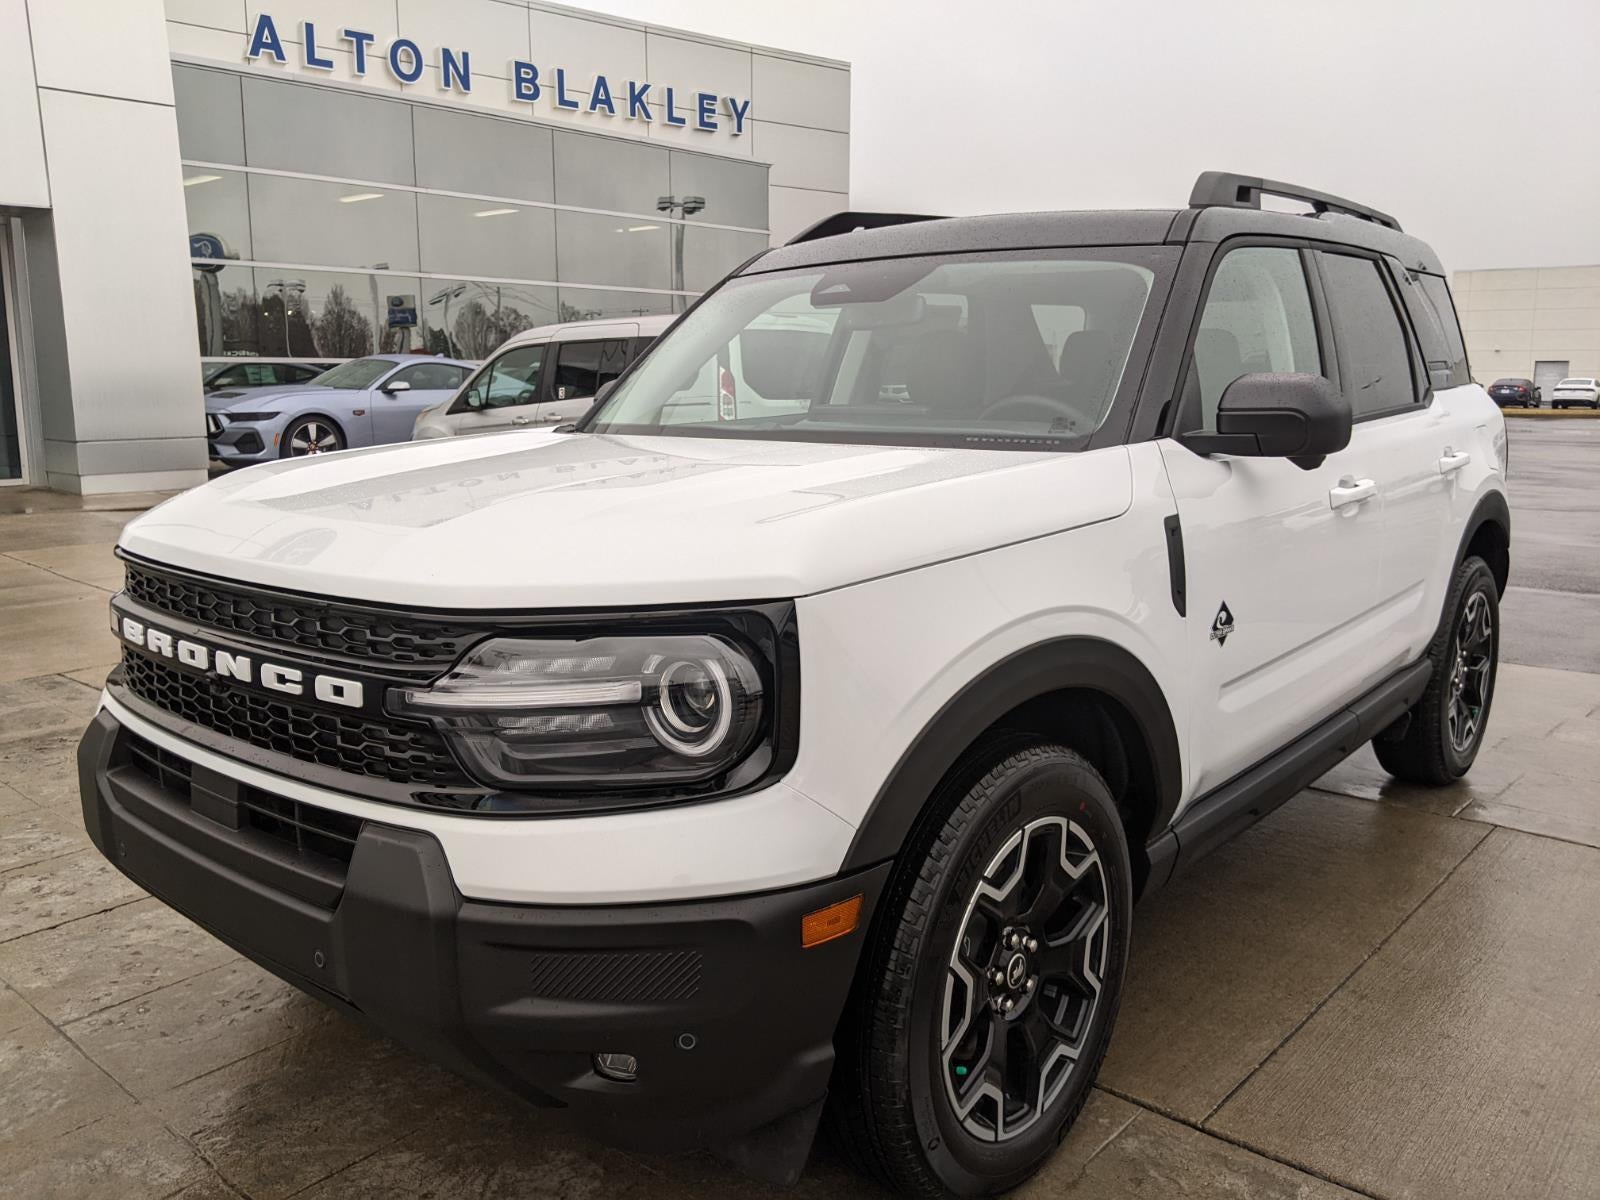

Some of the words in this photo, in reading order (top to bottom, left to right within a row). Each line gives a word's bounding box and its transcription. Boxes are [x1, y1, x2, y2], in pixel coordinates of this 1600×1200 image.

[246, 14, 471, 93] ALTON
[513, 60, 752, 136] BLAKLEY
[122, 617, 364, 708] BRONCO
